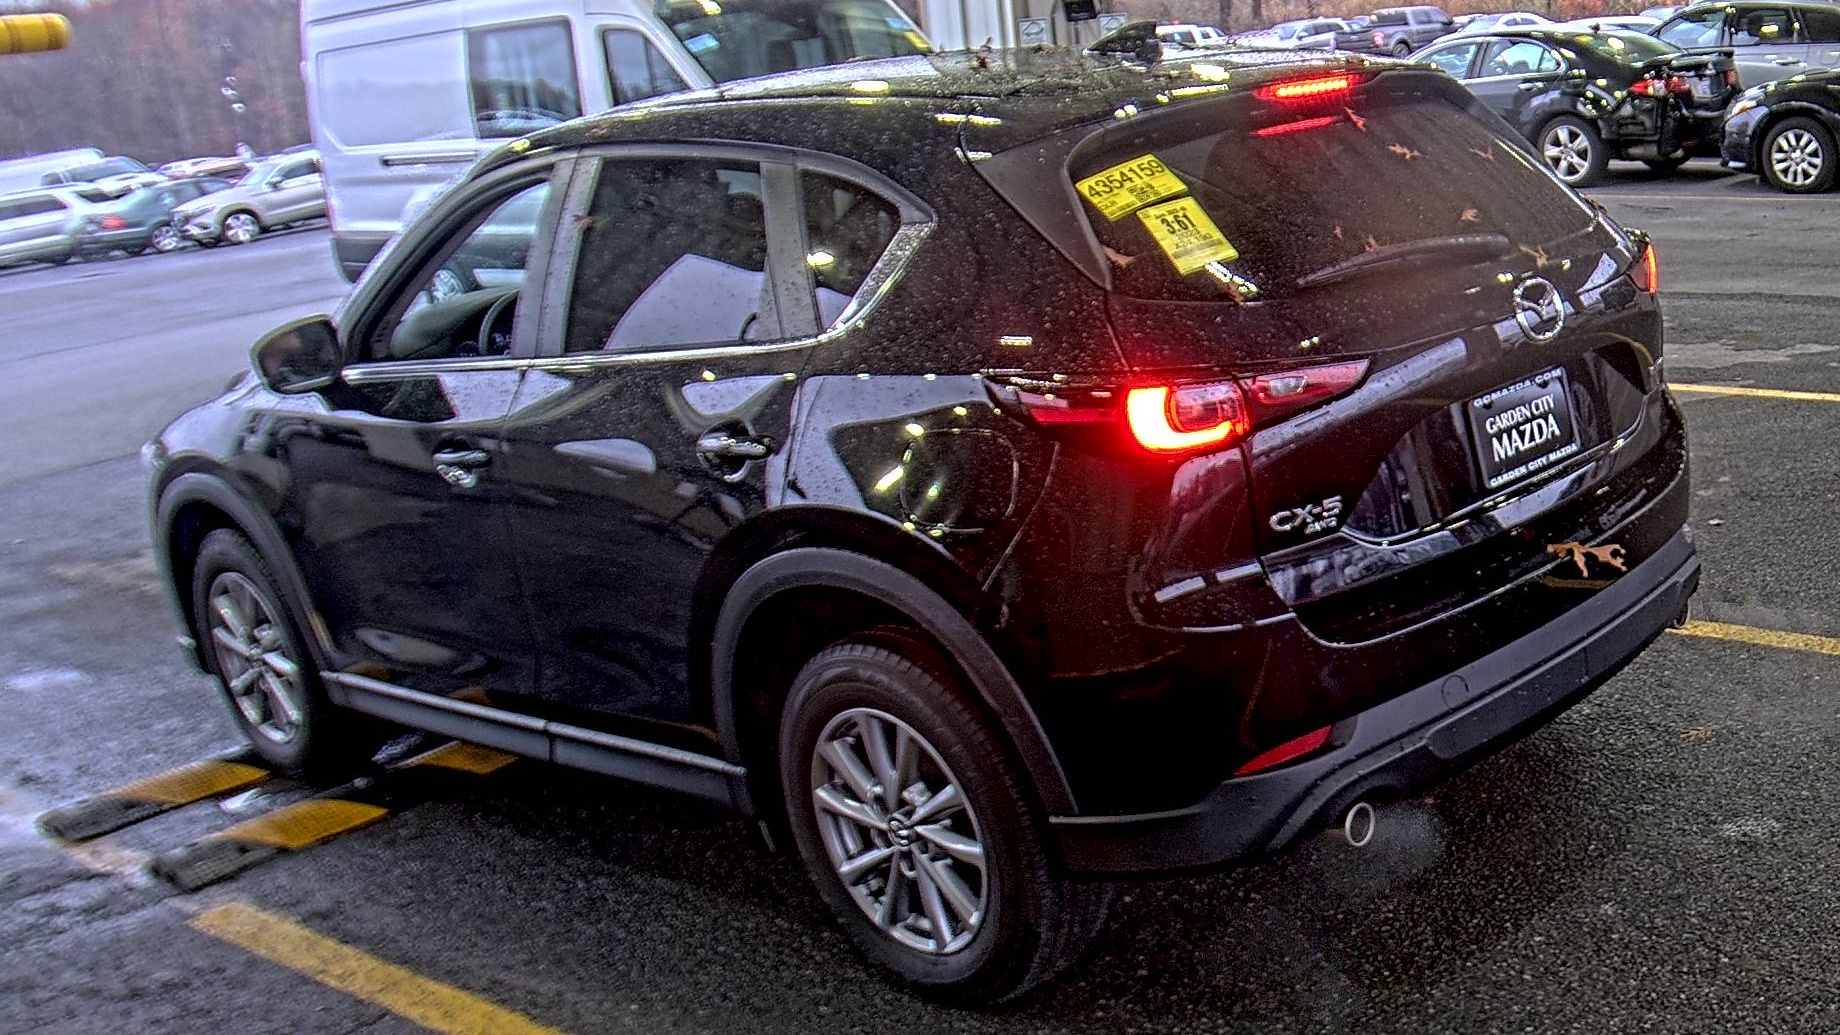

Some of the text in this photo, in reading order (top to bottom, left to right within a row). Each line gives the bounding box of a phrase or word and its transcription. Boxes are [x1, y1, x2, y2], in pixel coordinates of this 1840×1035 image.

[1088, 159, 1165, 198] 4354159
[1485, 393, 1554, 434] GARDEN CITY
[1491, 413, 1560, 462] MAZDA
[1490, 442, 1578, 487] GARDEN CITY MAZDA
[1269, 495, 1343, 531] CX-5
